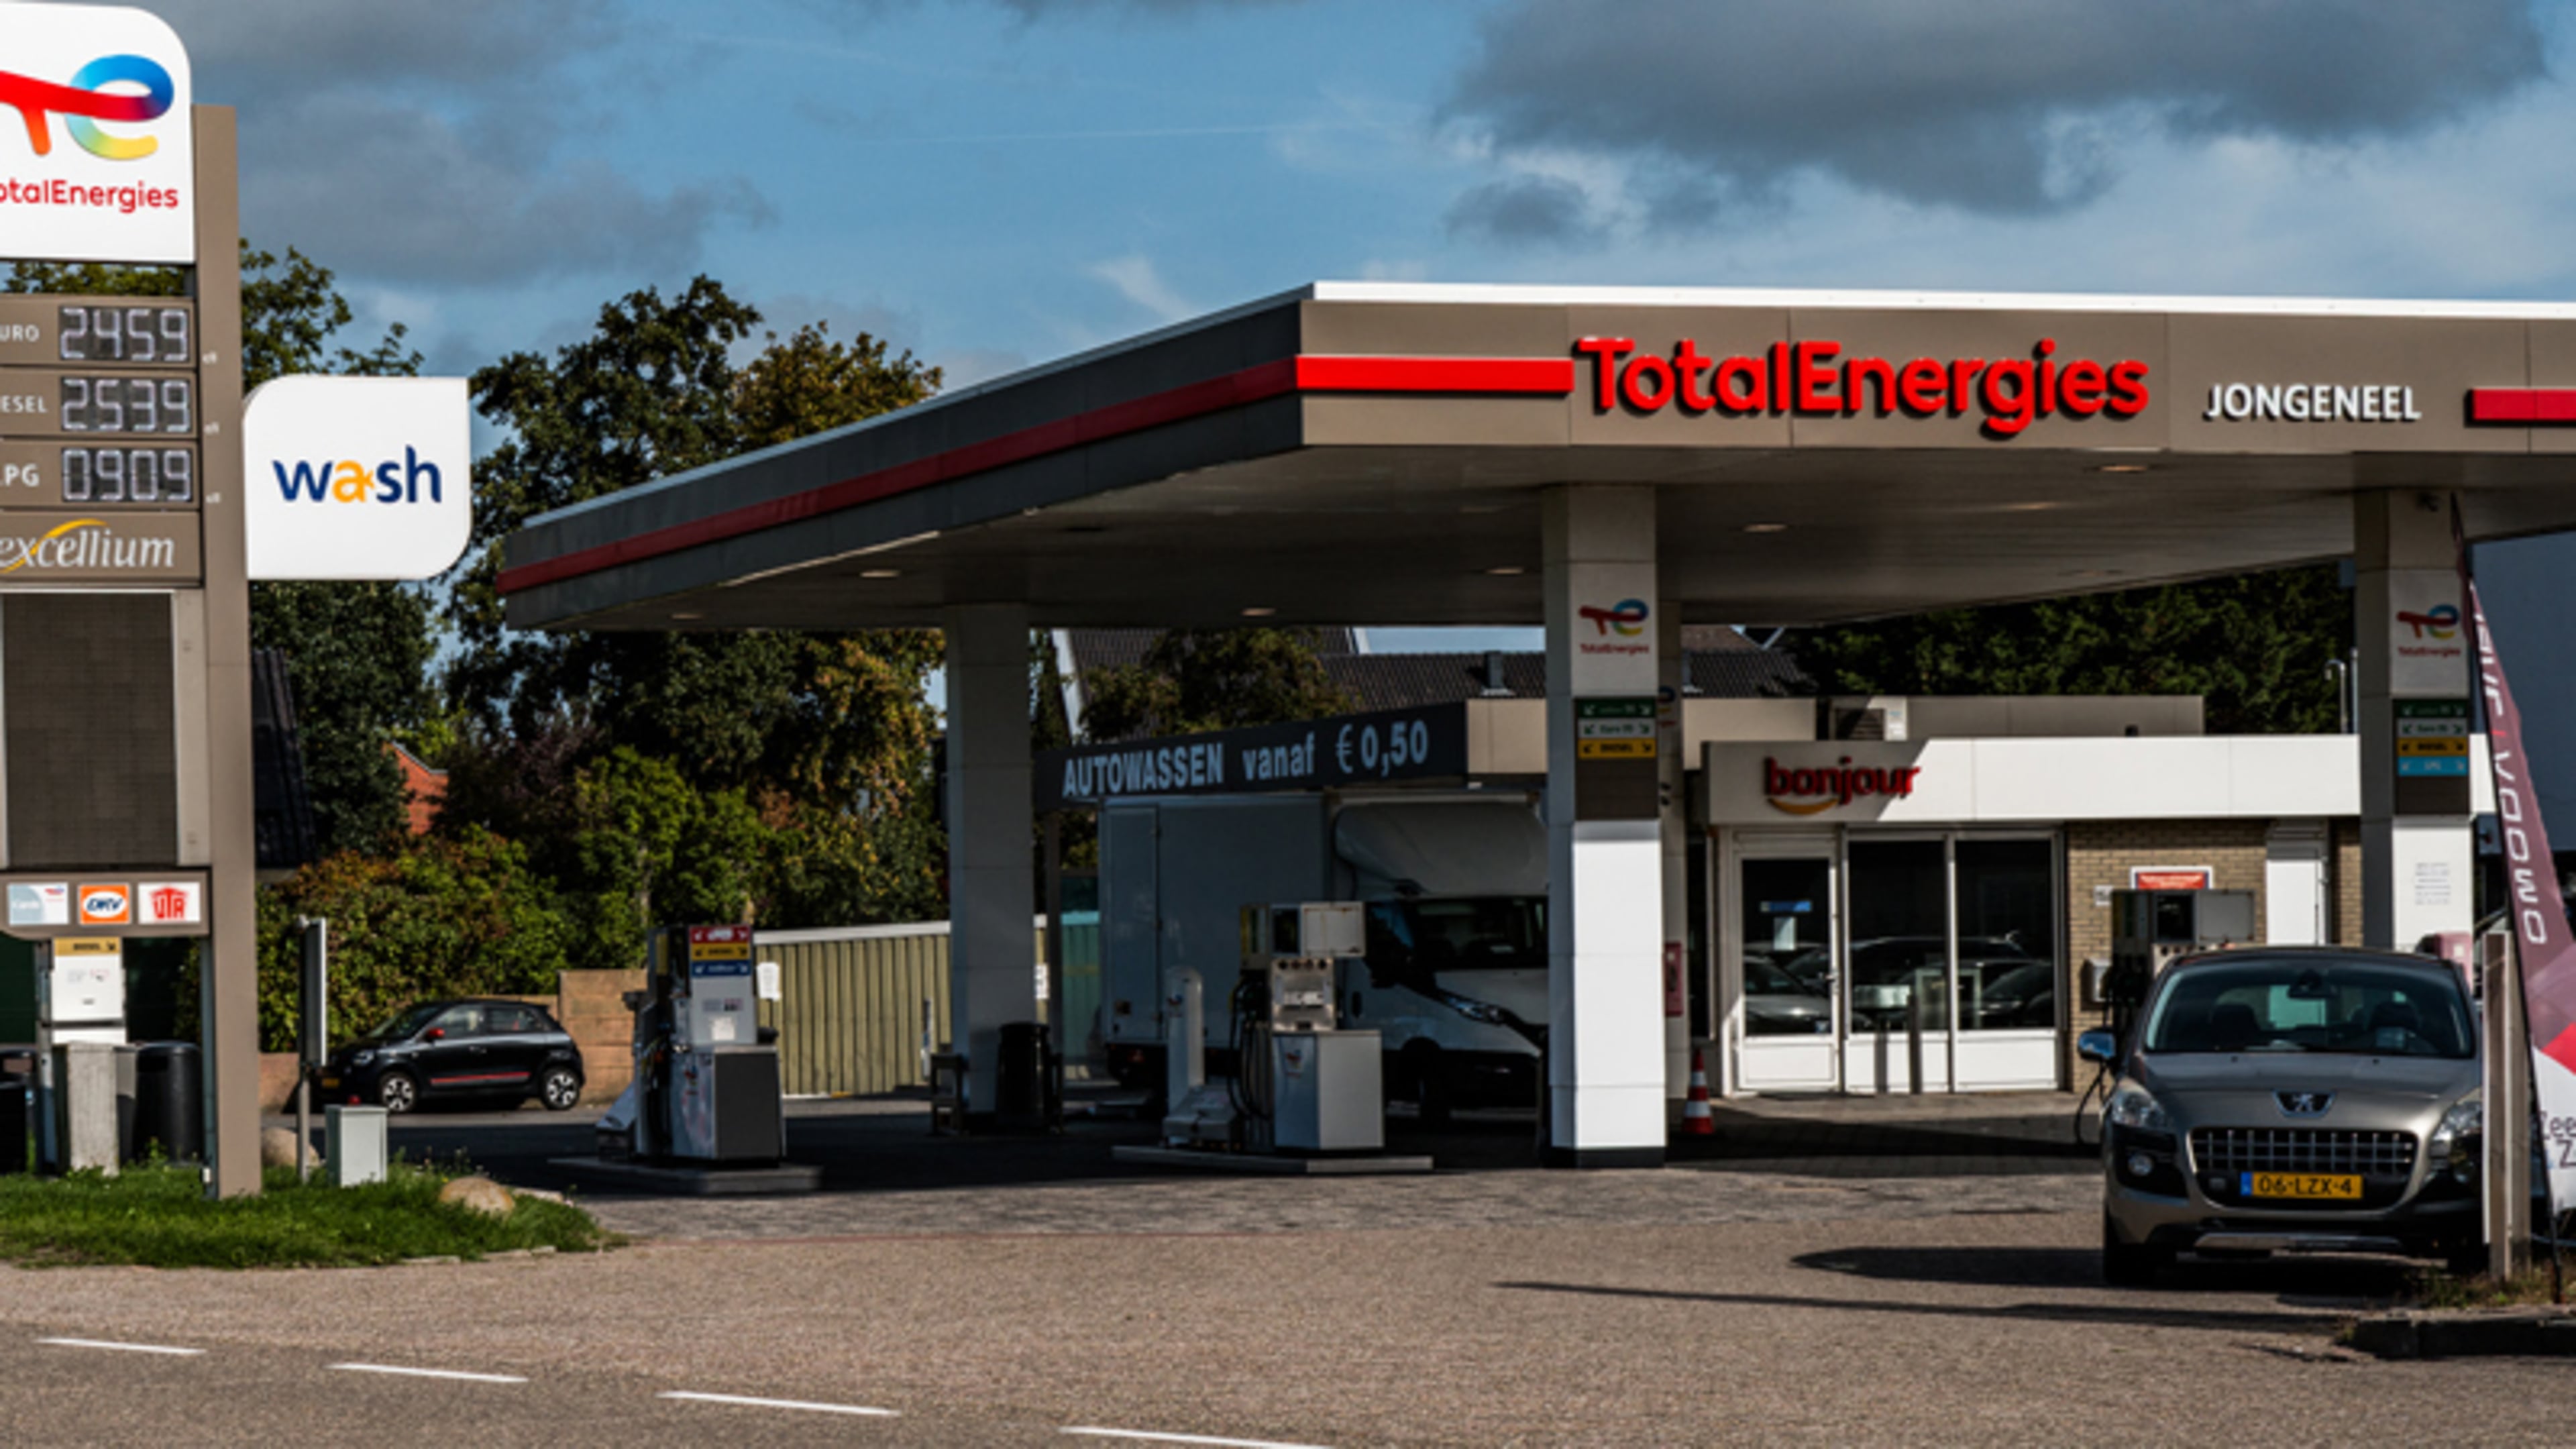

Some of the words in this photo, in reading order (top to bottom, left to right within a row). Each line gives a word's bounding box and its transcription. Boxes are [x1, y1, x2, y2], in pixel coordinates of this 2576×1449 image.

[0, 325, 40, 342] URO
[60, 307, 189, 361] 2459
[0, 395, 48, 413] ESEL
[62, 378, 191, 432] 2539
[1573, 337, 2149, 436] TotalEnergies
[2203, 382, 2422, 420] JONGENEEL
[0, 464, 40, 488] PG
[62, 449, 192, 500] 0909
[272, 444, 443, 504] wash
[0, 528, 174, 568] excellium
[1062, 743, 1225, 798] AUTOWASSEN
[1242, 733, 1316, 781] vanaf
[1764, 755, 1923, 806] bonjour
[148, 885, 189, 920] UTA
